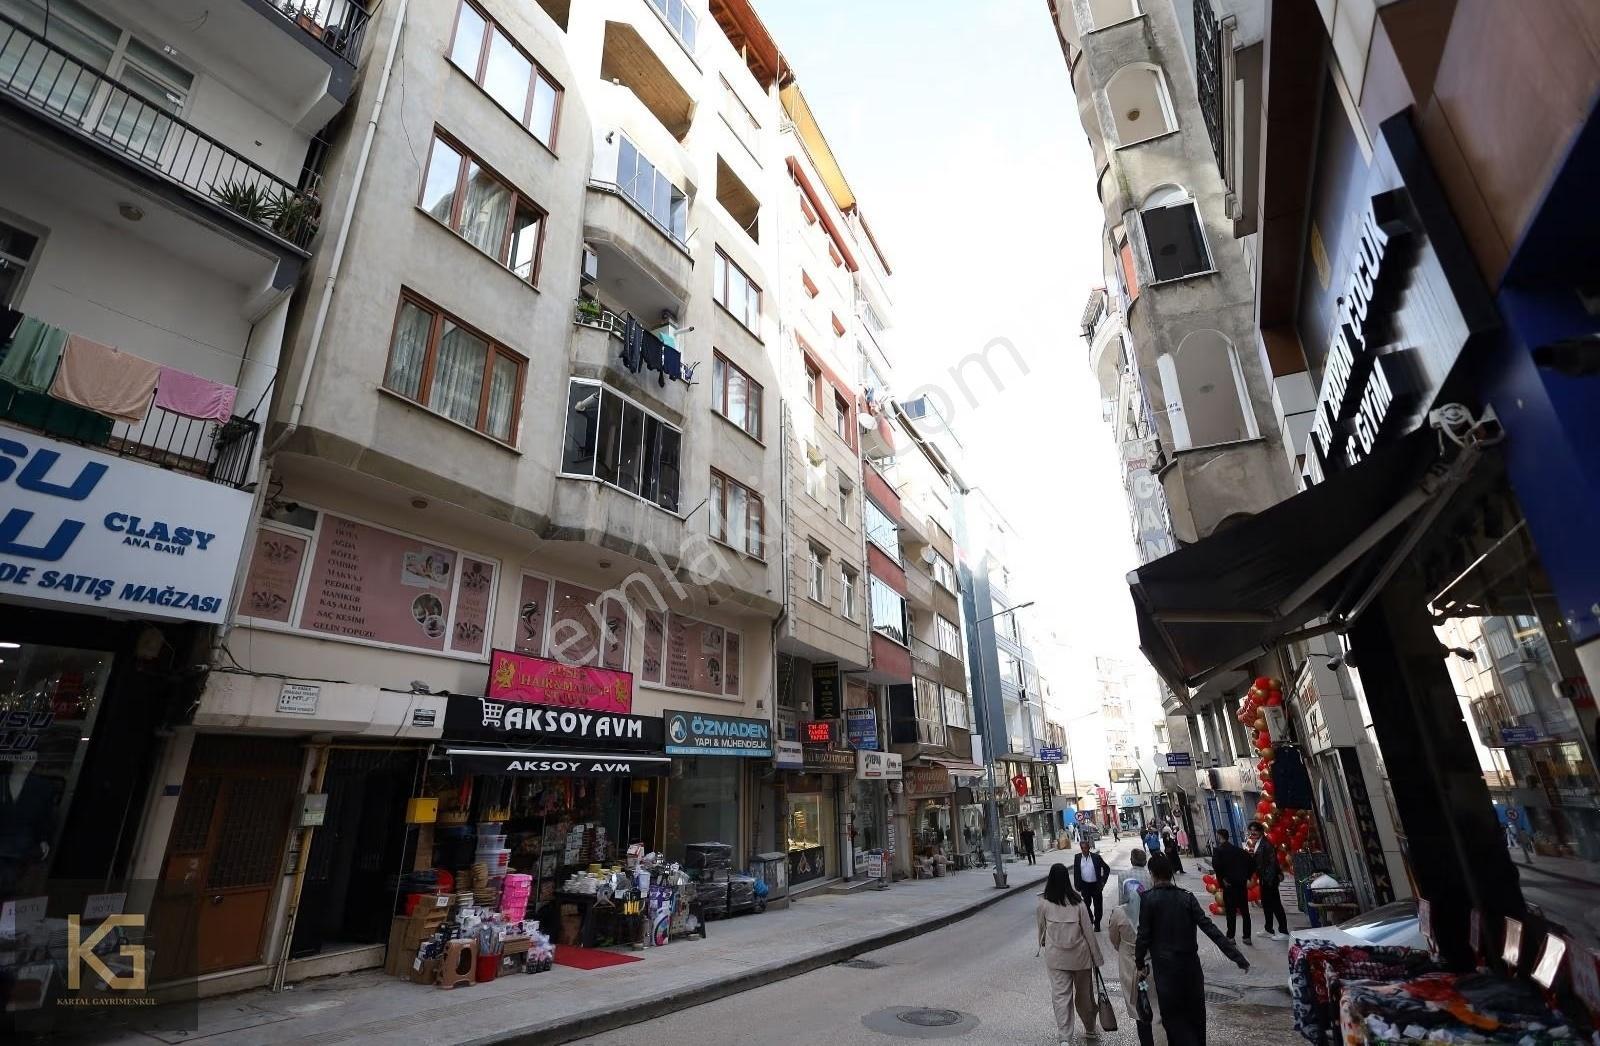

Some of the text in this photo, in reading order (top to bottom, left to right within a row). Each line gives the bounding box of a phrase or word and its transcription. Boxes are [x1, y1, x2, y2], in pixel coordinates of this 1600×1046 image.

[1327, 326, 1355, 421] BAYAN
[1344, 211, 1389, 351] ÇOCUK
[104, 512, 216, 550] CLASY
[122, 536, 151, 549] ANA
[38, 570, 115, 601] SATIŞ
[119, 584, 223, 614] MAĞZASI
[504, 707, 642, 739] AKSOY AVM
[691, 716, 768, 738] ÖZMADEN
[694, 737, 712, 747] YAPI
[713, 739, 720, 747] &
[506, 760, 631, 773] AKSOY AVM
